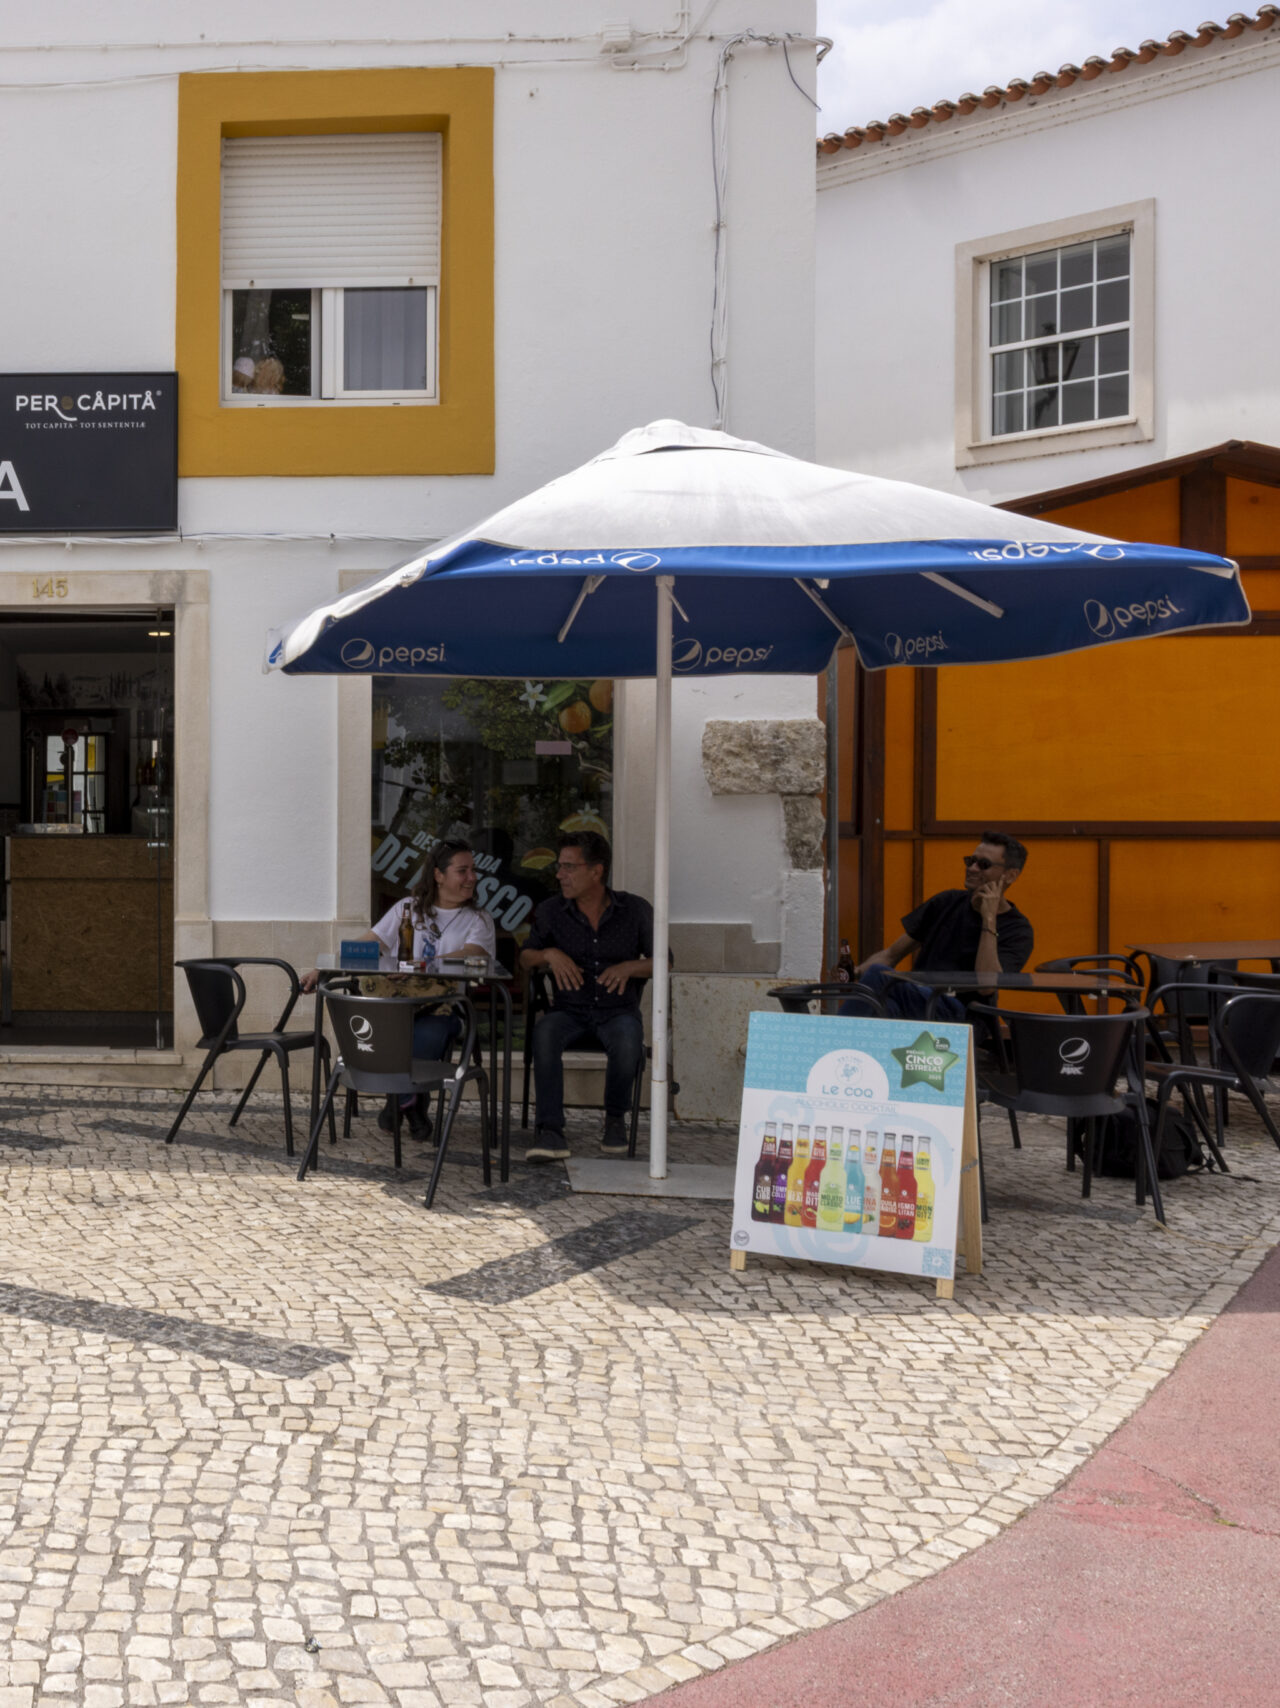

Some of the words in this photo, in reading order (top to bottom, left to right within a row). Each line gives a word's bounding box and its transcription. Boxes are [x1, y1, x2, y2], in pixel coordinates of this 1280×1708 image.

[16, 395, 77, 421] PER
[32, 578, 69, 598] 145
[1113, 595, 1181, 628] pepsi
[378, 643, 445, 666] pepsi
[705, 645, 773, 666] pepsi
[904, 631, 947, 659] pepsi
[371, 833, 420, 884] DE
[905, 1064, 943, 1073] ESTRELAS
[906, 1055, 943, 1066] CINCO
